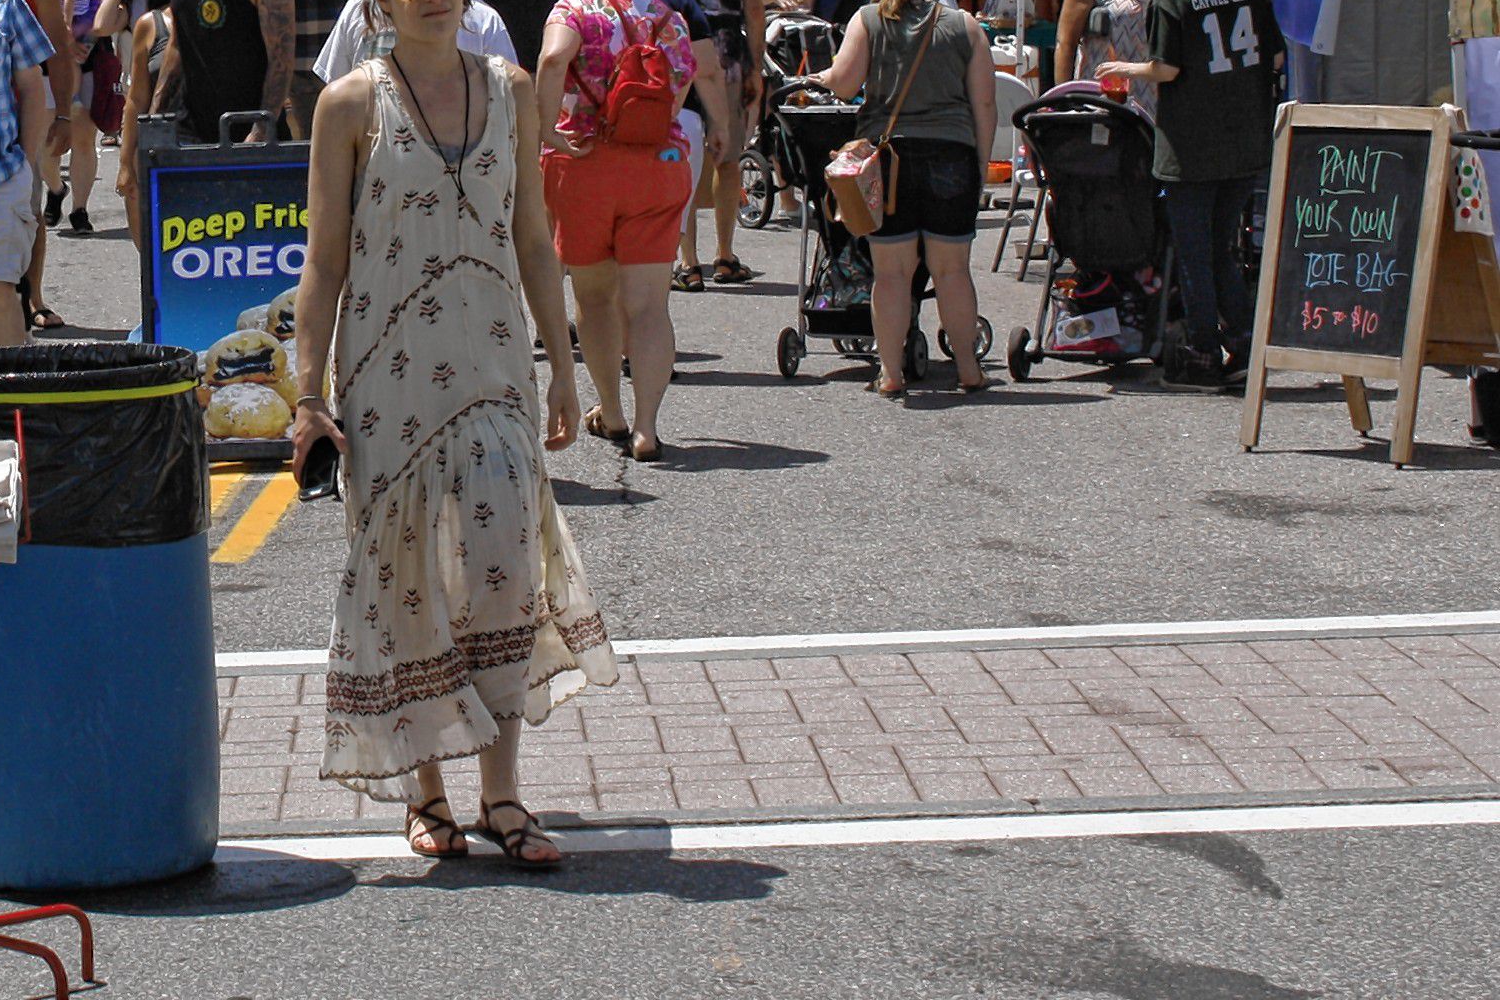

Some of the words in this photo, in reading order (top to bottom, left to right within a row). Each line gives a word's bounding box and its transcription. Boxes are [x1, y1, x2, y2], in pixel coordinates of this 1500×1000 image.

[1202, 5, 1260, 74] 14
[1318, 145, 1404, 194] PAINT
[161, 210, 246, 252] Deep
[1293, 195, 1342, 248] YOUR
[1350, 194, 1399, 242] OWN
[171, 243, 308, 280] OREO
[1304, 252, 1349, 289] TOTE
[1354, 252, 1408, 292] BAG
[1301, 300, 1329, 331] $5
[1350, 304, 1380, 339] $10
